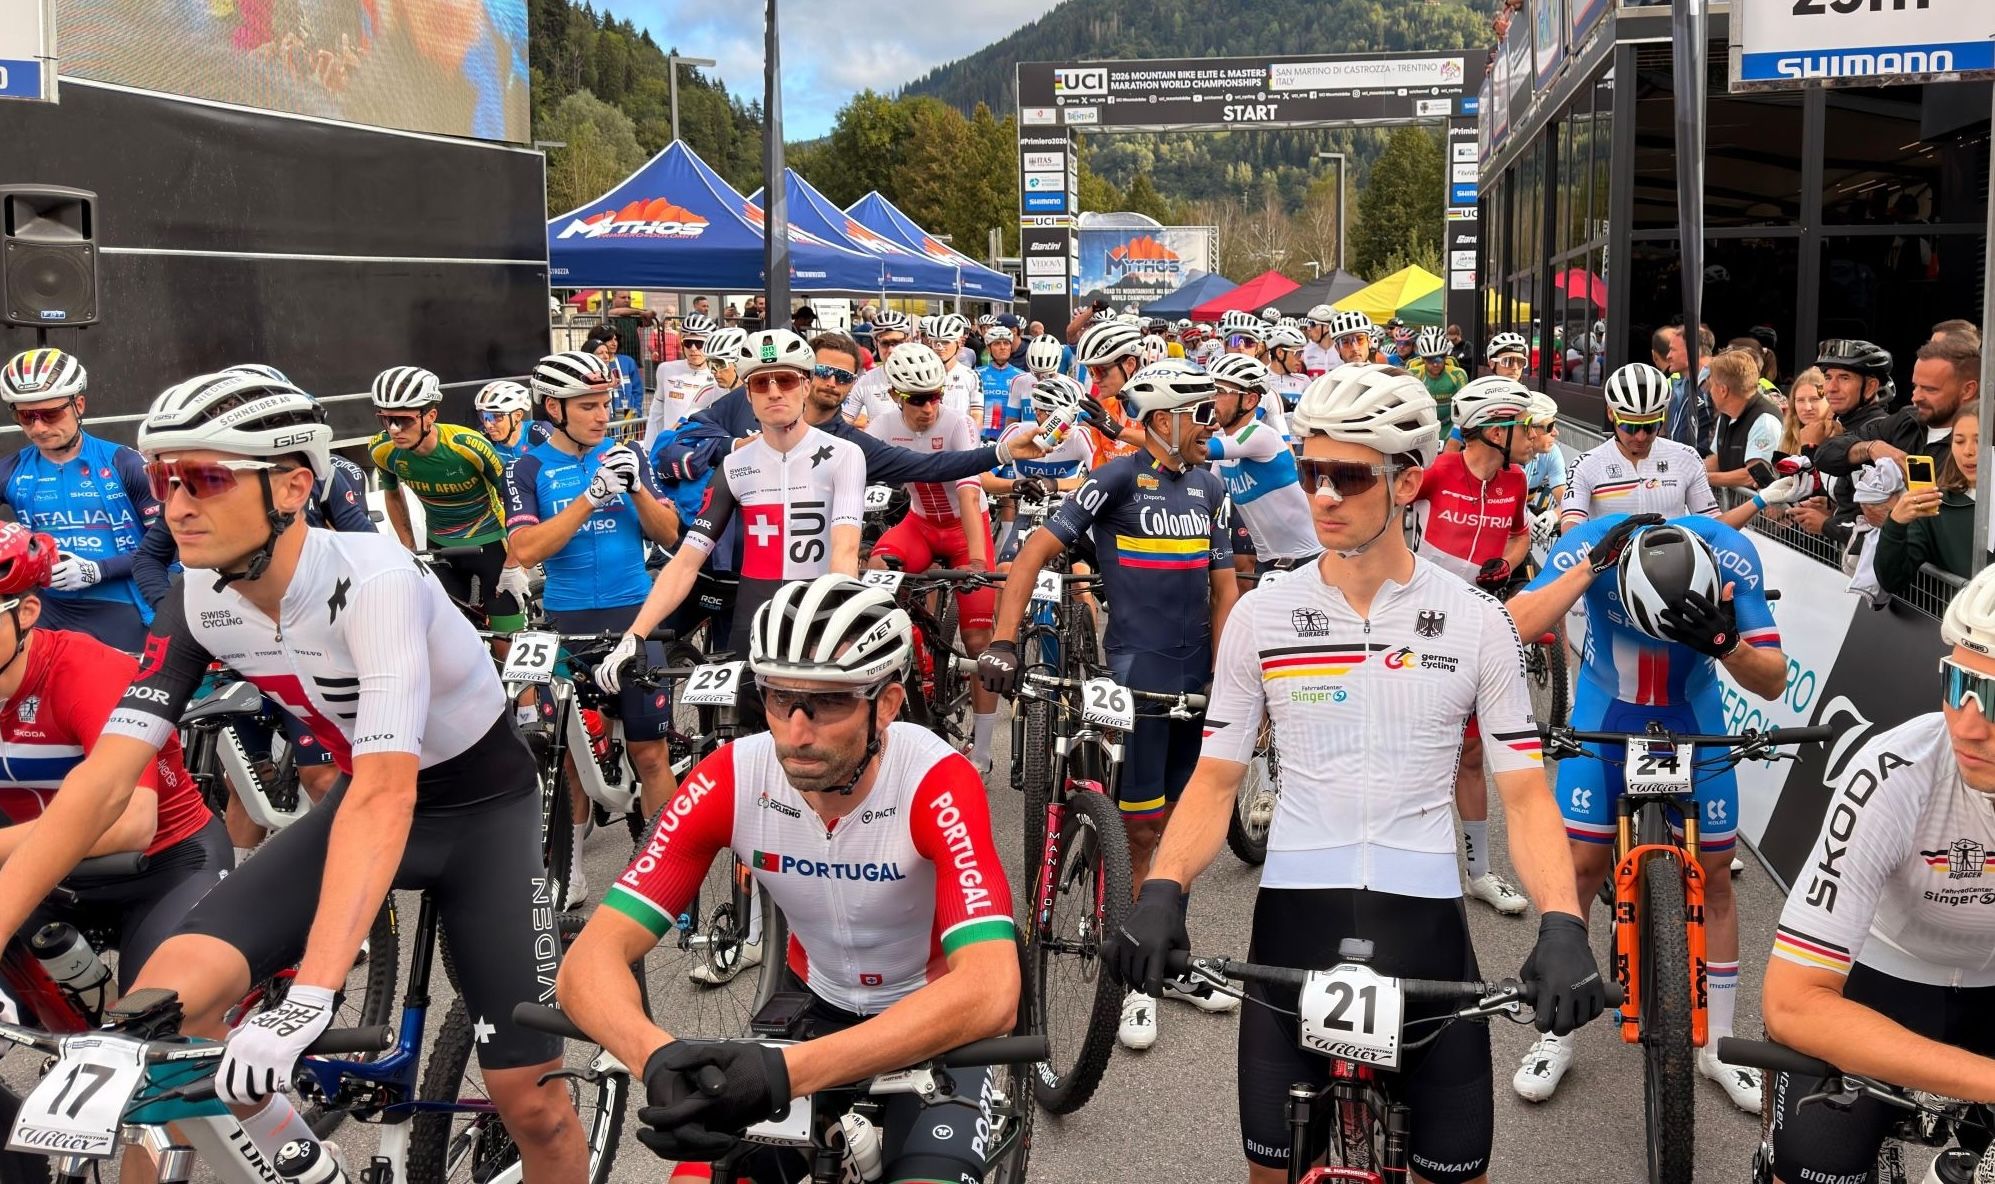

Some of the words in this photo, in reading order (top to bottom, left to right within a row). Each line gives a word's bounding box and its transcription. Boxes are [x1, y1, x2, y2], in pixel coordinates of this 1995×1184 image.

[1131, 71, 1176, 80] MOUNTAIN
[1178, 71, 1197, 79] BIKE
[1198, 70, 1219, 78] ELITE
[1220, 70, 1226, 78] &
[1227, 69, 1266, 78] MASTERS
[1276, 67, 1292, 76] SAN
[1295, 66, 1331, 75] MARTINO
[1333, 65, 1342, 74] DI
[1344, 64, 1390, 74] CASTROZZA
[1398, 63, 1437, 72] TRENTINO
[1064, 73, 1103, 90] UCI
[1111, 81, 1159, 90] MARATHON
[1160, 80, 1191, 89] WORLD
[1192, 78, 1262, 88] CHAMPIONSHIPS
[1276, 77, 1296, 86] ITALY
[1223, 105, 1278, 121] START
[1029, 198, 1061, 206] SHIMANO
[557, 215, 711, 239] MYTHOS
[1035, 217, 1055, 226] UCI
[1030, 242, 1062, 251] Santini
[1105, 249, 1181, 276] MYTHOS
[1133, 368, 1184, 380] RUDY
[194, 376, 244, 404] NIEDERER
[154, 413, 180, 422] GIST
[220, 400, 276, 426] SCHNEIDER
[277, 396, 292, 405] AG
[273, 430, 317, 448] GIST
[330, 456, 362, 481] Cofidis
[730, 466, 753, 475] SWISS
[730, 469, 761, 481] CYCLING
[1024, 466, 1068, 476] ITALIA
[435, 476, 480, 494] AFRICA
[1224, 474, 1258, 495] TALIA
[866, 490, 885, 504] 43
[1438, 509, 1513, 529] AUSTRIA
[789, 501, 826, 564] SUI
[1711, 548, 1760, 591] KODA
[867, 573, 895, 586] 32
[201, 610, 231, 620] SWISS
[203, 617, 243, 629] CYCLING
[857, 617, 894, 655] MET
[1468, 587, 1498, 604] BIKE
[1497, 605, 1527, 679] INDUSTRIES
[513, 642, 549, 667] 25
[1422, 653, 1460, 665] german
[1421, 660, 1457, 673] cycling
[693, 668, 732, 690] 29
[123, 686, 169, 706] DOR
[1091, 685, 1126, 713] 26
[1292, 690, 1332, 703] Singer
[157, 758, 177, 789] AkerBP
[1637, 754, 1681, 776] 24
[1630, 783, 1689, 793] Wilier
[770, 802, 801, 819] CICLISMO
[622, 772, 716, 887] PORTUGAL
[1806, 751, 1915, 914] ŠKODA
[929, 791, 993, 915] PORTUGAL
[781, 855, 906, 882] PORTUGAL
[1043, 831, 1060, 906] MANITO
[1948, 871, 1983, 880] BIORACER
[1923, 890, 1979, 906] Singer
[531, 877, 560, 1003] VIDEN
[1323, 980, 1378, 1035] 21
[1306, 1034, 1393, 1062] Wilier
[1363, 1047, 1394, 1056] TRIESTINA
[47, 1062, 117, 1119] 17
[18, 1126, 108, 1150] Wilier
[75, 1134, 110, 1142] TRIESTINA
[1247, 1138, 1290, 1158] BIORAC
[1412, 1153, 1483, 1174] GERMANY
[1333, 1169, 1369, 1177] SUSPENSION
[1800, 1167, 1868, 1184] BIORACER
